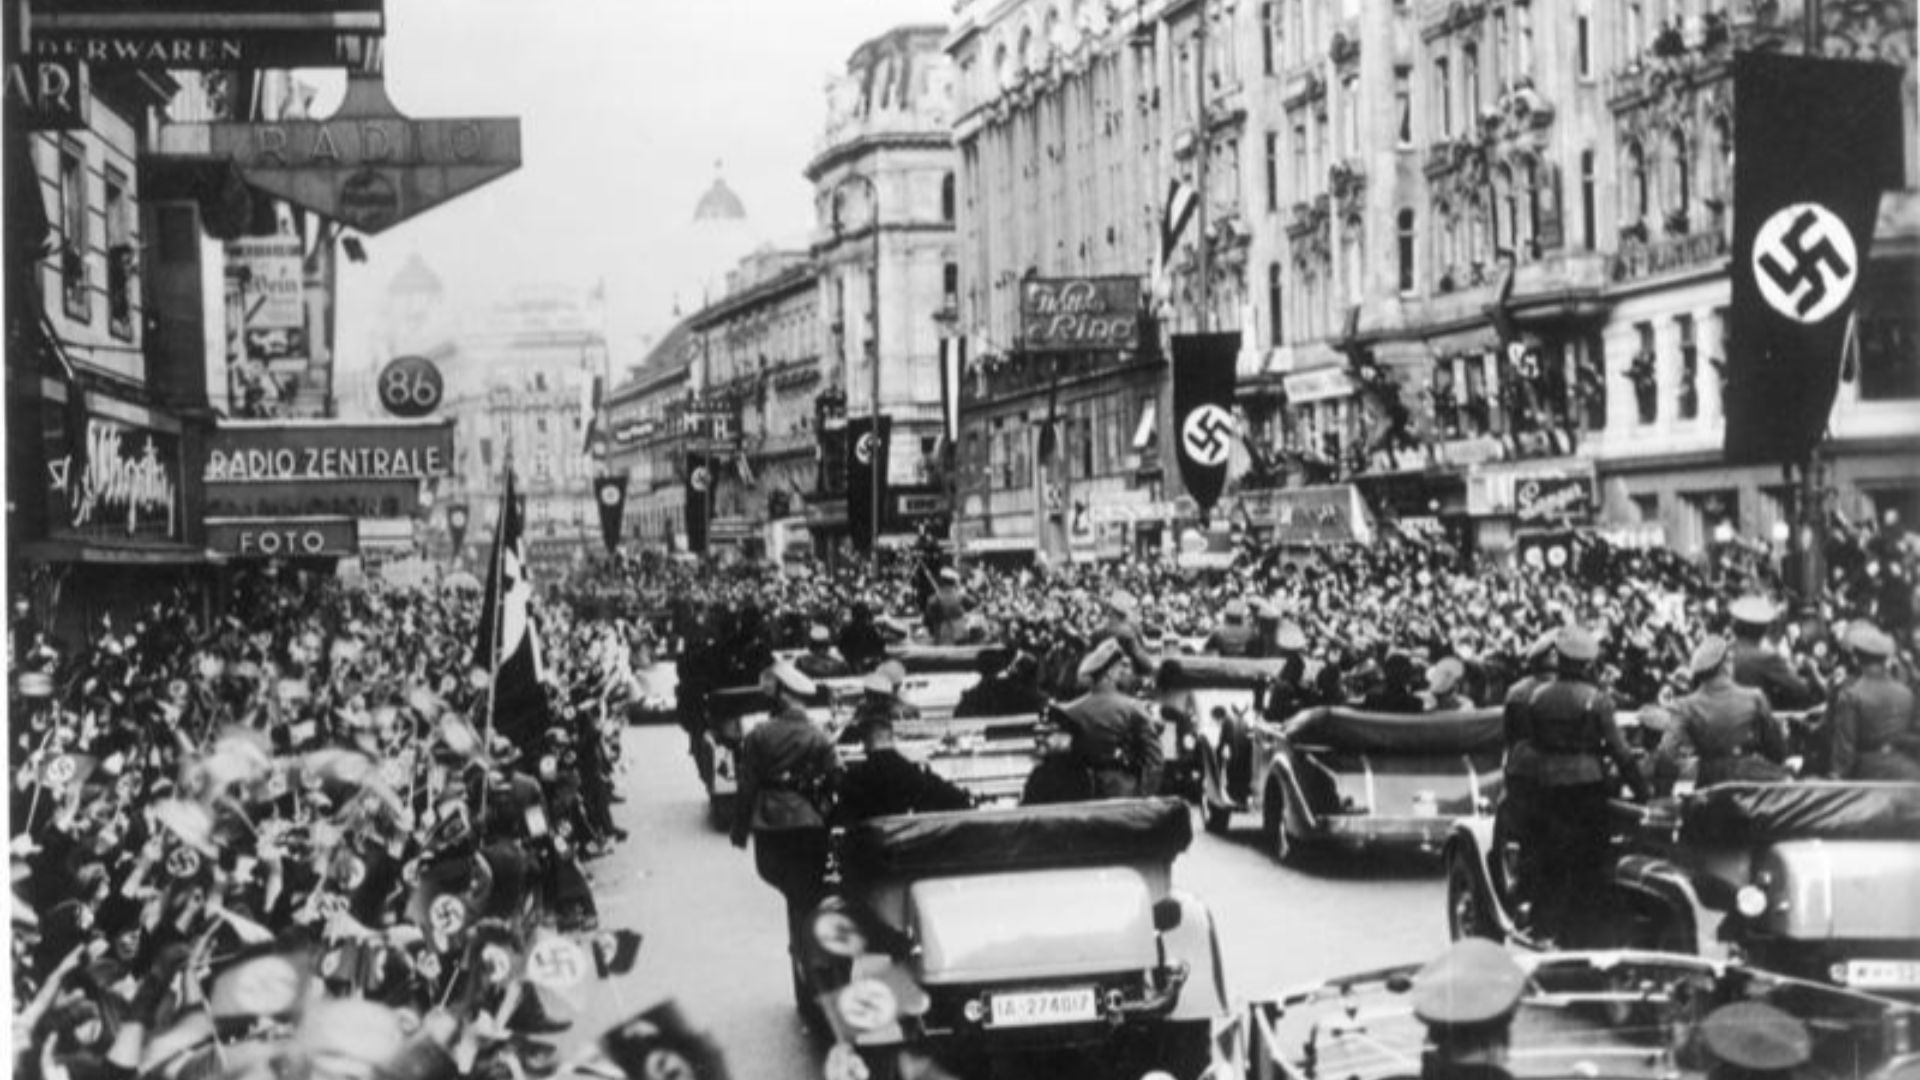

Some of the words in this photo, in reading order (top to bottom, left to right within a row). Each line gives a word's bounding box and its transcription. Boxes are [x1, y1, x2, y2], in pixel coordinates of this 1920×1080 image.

[257, 122, 482, 162] RADIO
[385, 366, 437, 406] 86
[206, 449, 296, 479] RADIO
[304, 446, 441, 478] ZENTRALE
[240, 530, 325, 553] FOTO
